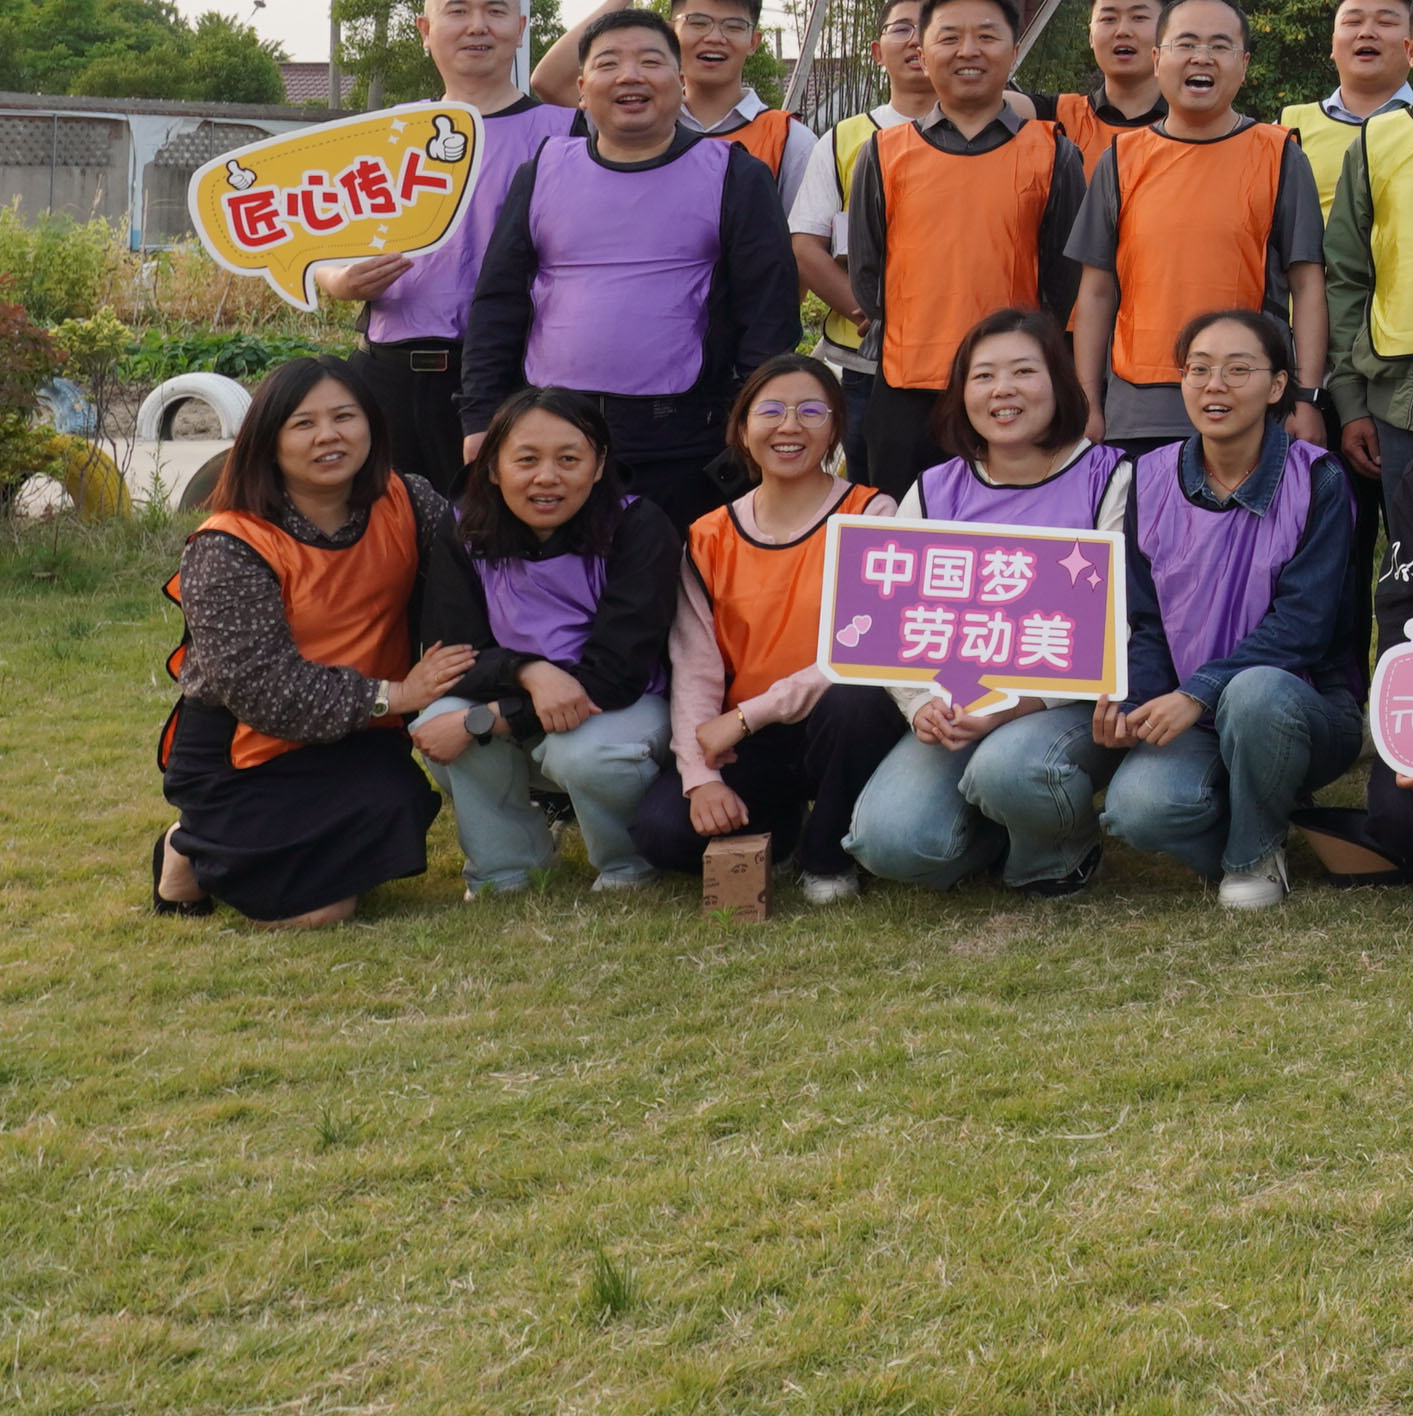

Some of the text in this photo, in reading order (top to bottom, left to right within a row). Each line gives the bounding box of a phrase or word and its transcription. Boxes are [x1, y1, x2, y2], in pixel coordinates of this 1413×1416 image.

[227, 151, 447, 247] 匠心传人
[865, 544, 1033, 602] 中国梦
[901, 606, 1072, 668] 劳动美
